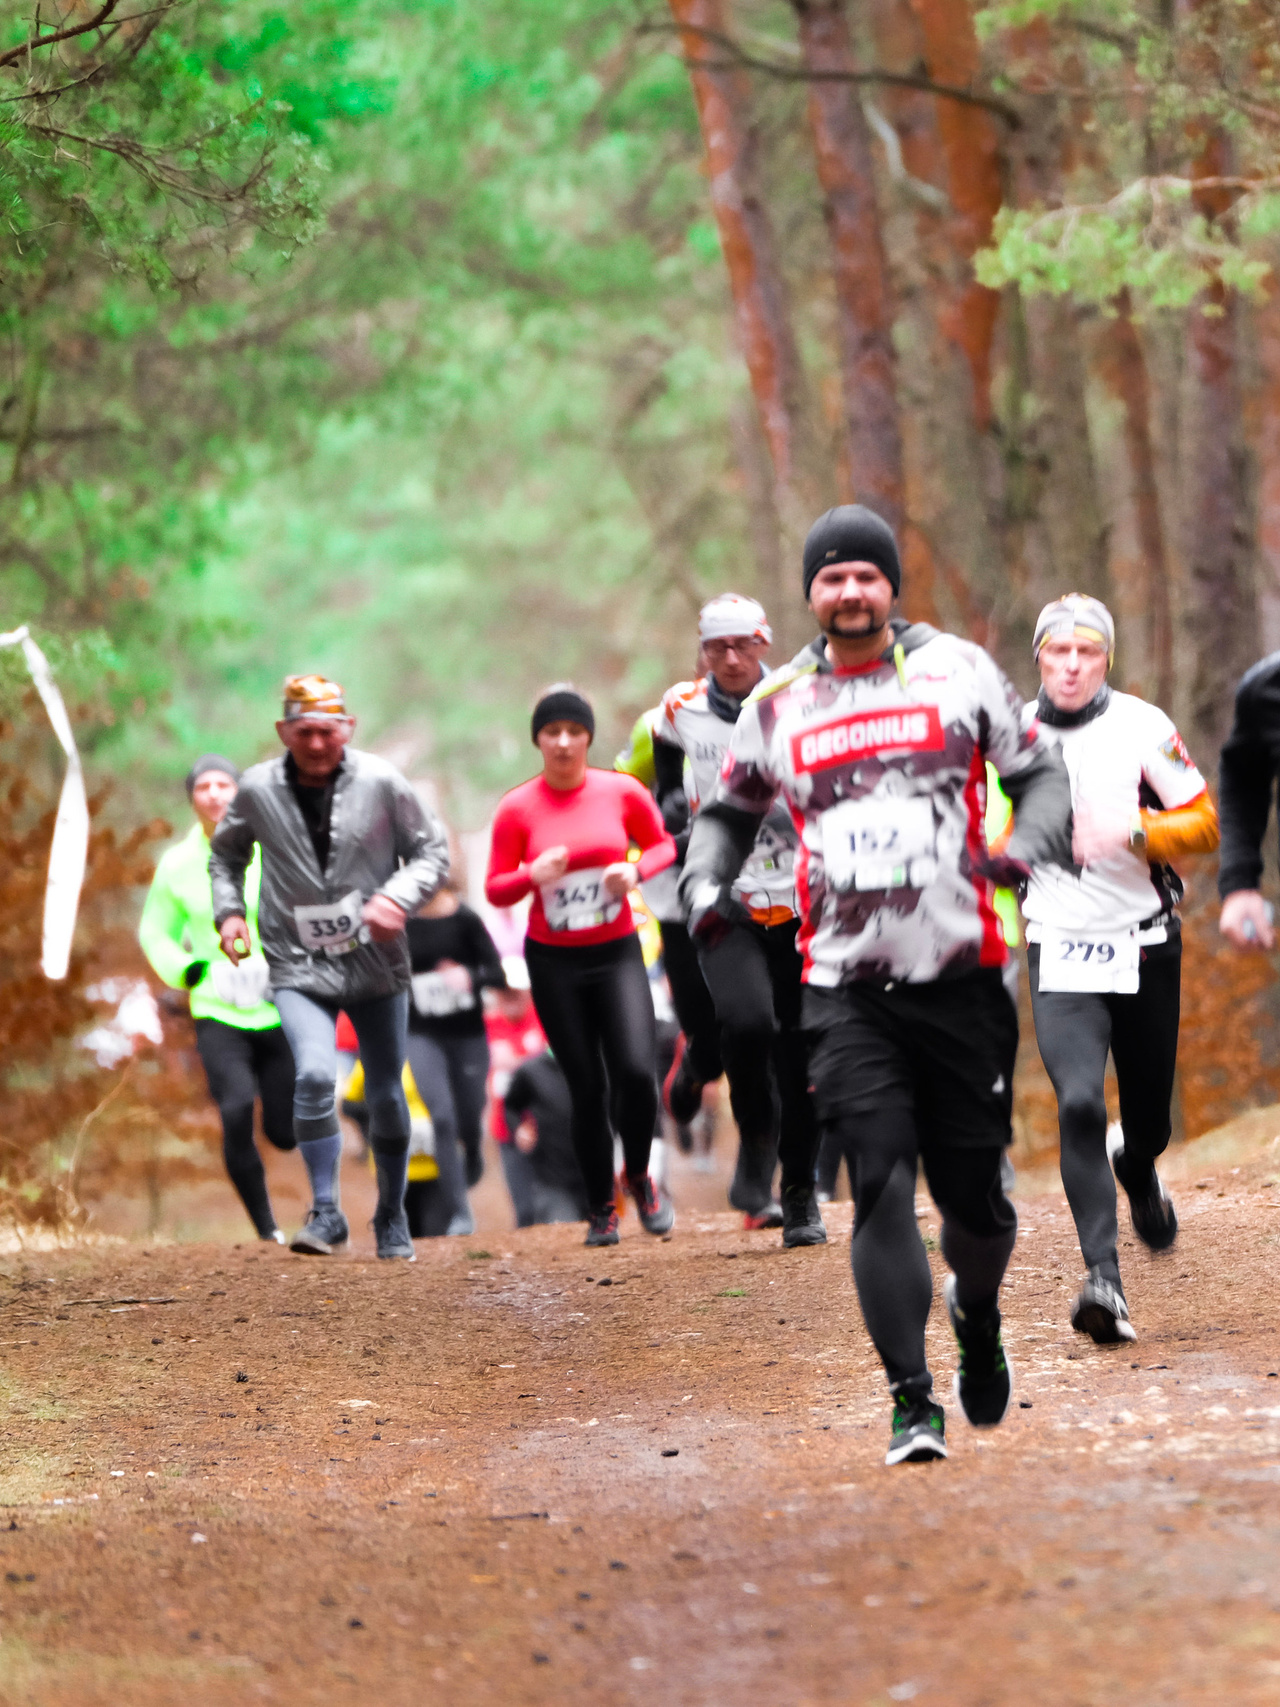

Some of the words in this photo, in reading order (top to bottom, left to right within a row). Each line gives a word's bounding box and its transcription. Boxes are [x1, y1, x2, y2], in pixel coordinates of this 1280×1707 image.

[554, 883, 599, 908] 347
[309, 915, 352, 938] 339
[1059, 940, 1115, 964] 279
